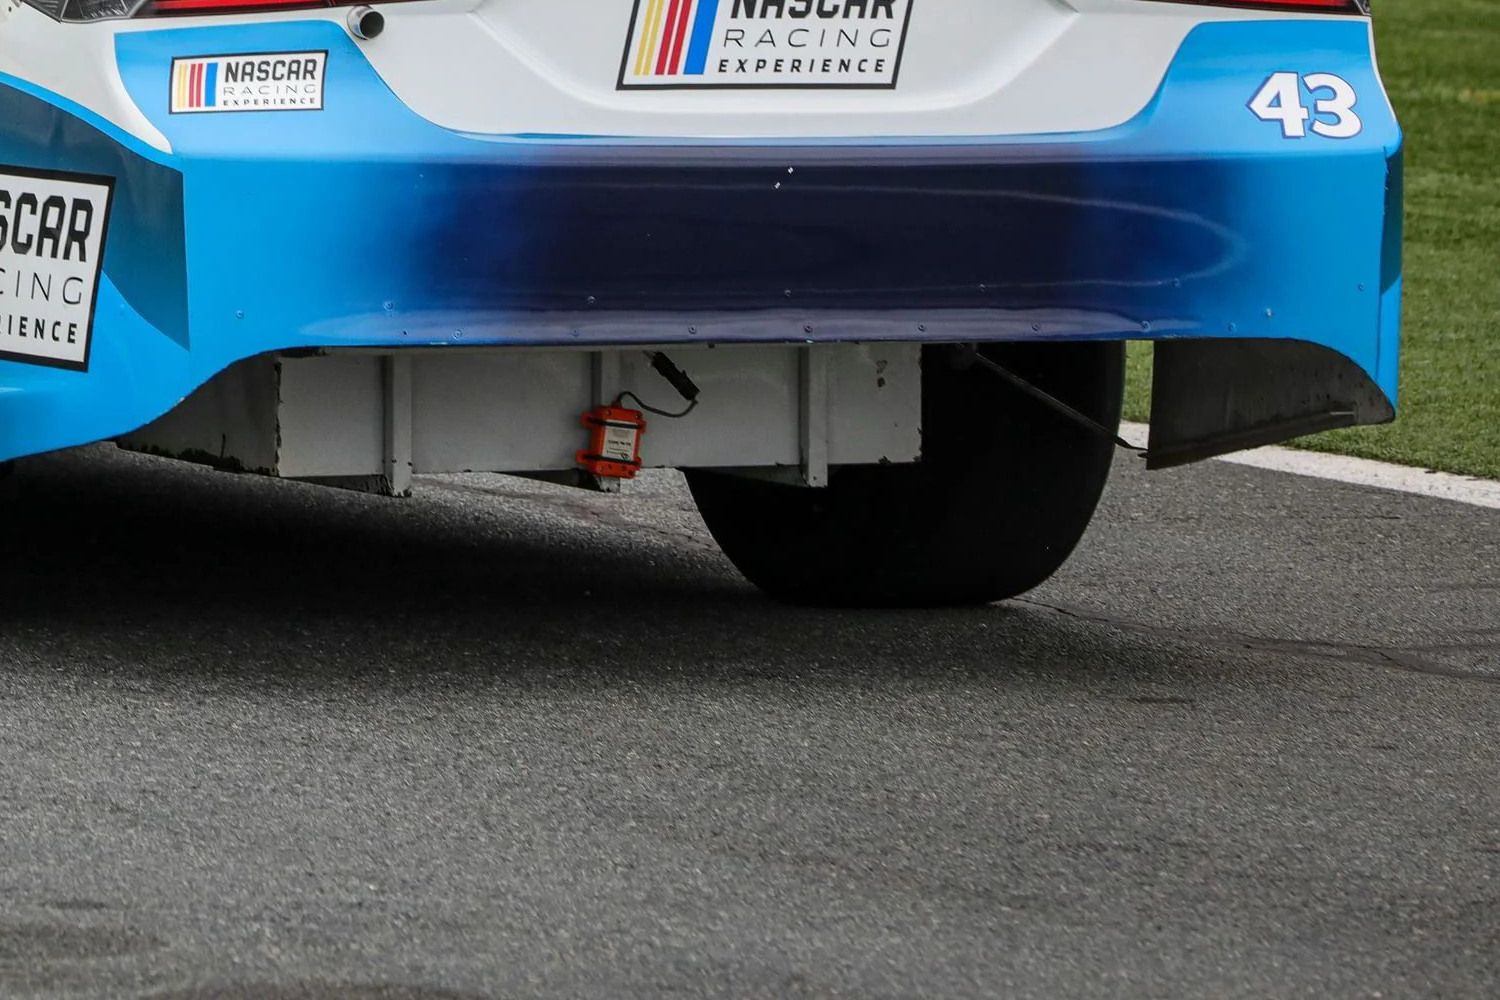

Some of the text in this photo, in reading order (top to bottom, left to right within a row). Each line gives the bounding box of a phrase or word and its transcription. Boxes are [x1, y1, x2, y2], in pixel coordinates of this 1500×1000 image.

[723, 28, 892, 48] RACING
[225, 59, 317, 82] NASCAR
[718, 59, 886, 73] EXPERIENCE
[223, 84, 317, 96] RACING
[223, 98, 316, 106] EXPERIENCE
[1245, 71, 1363, 139] 43
